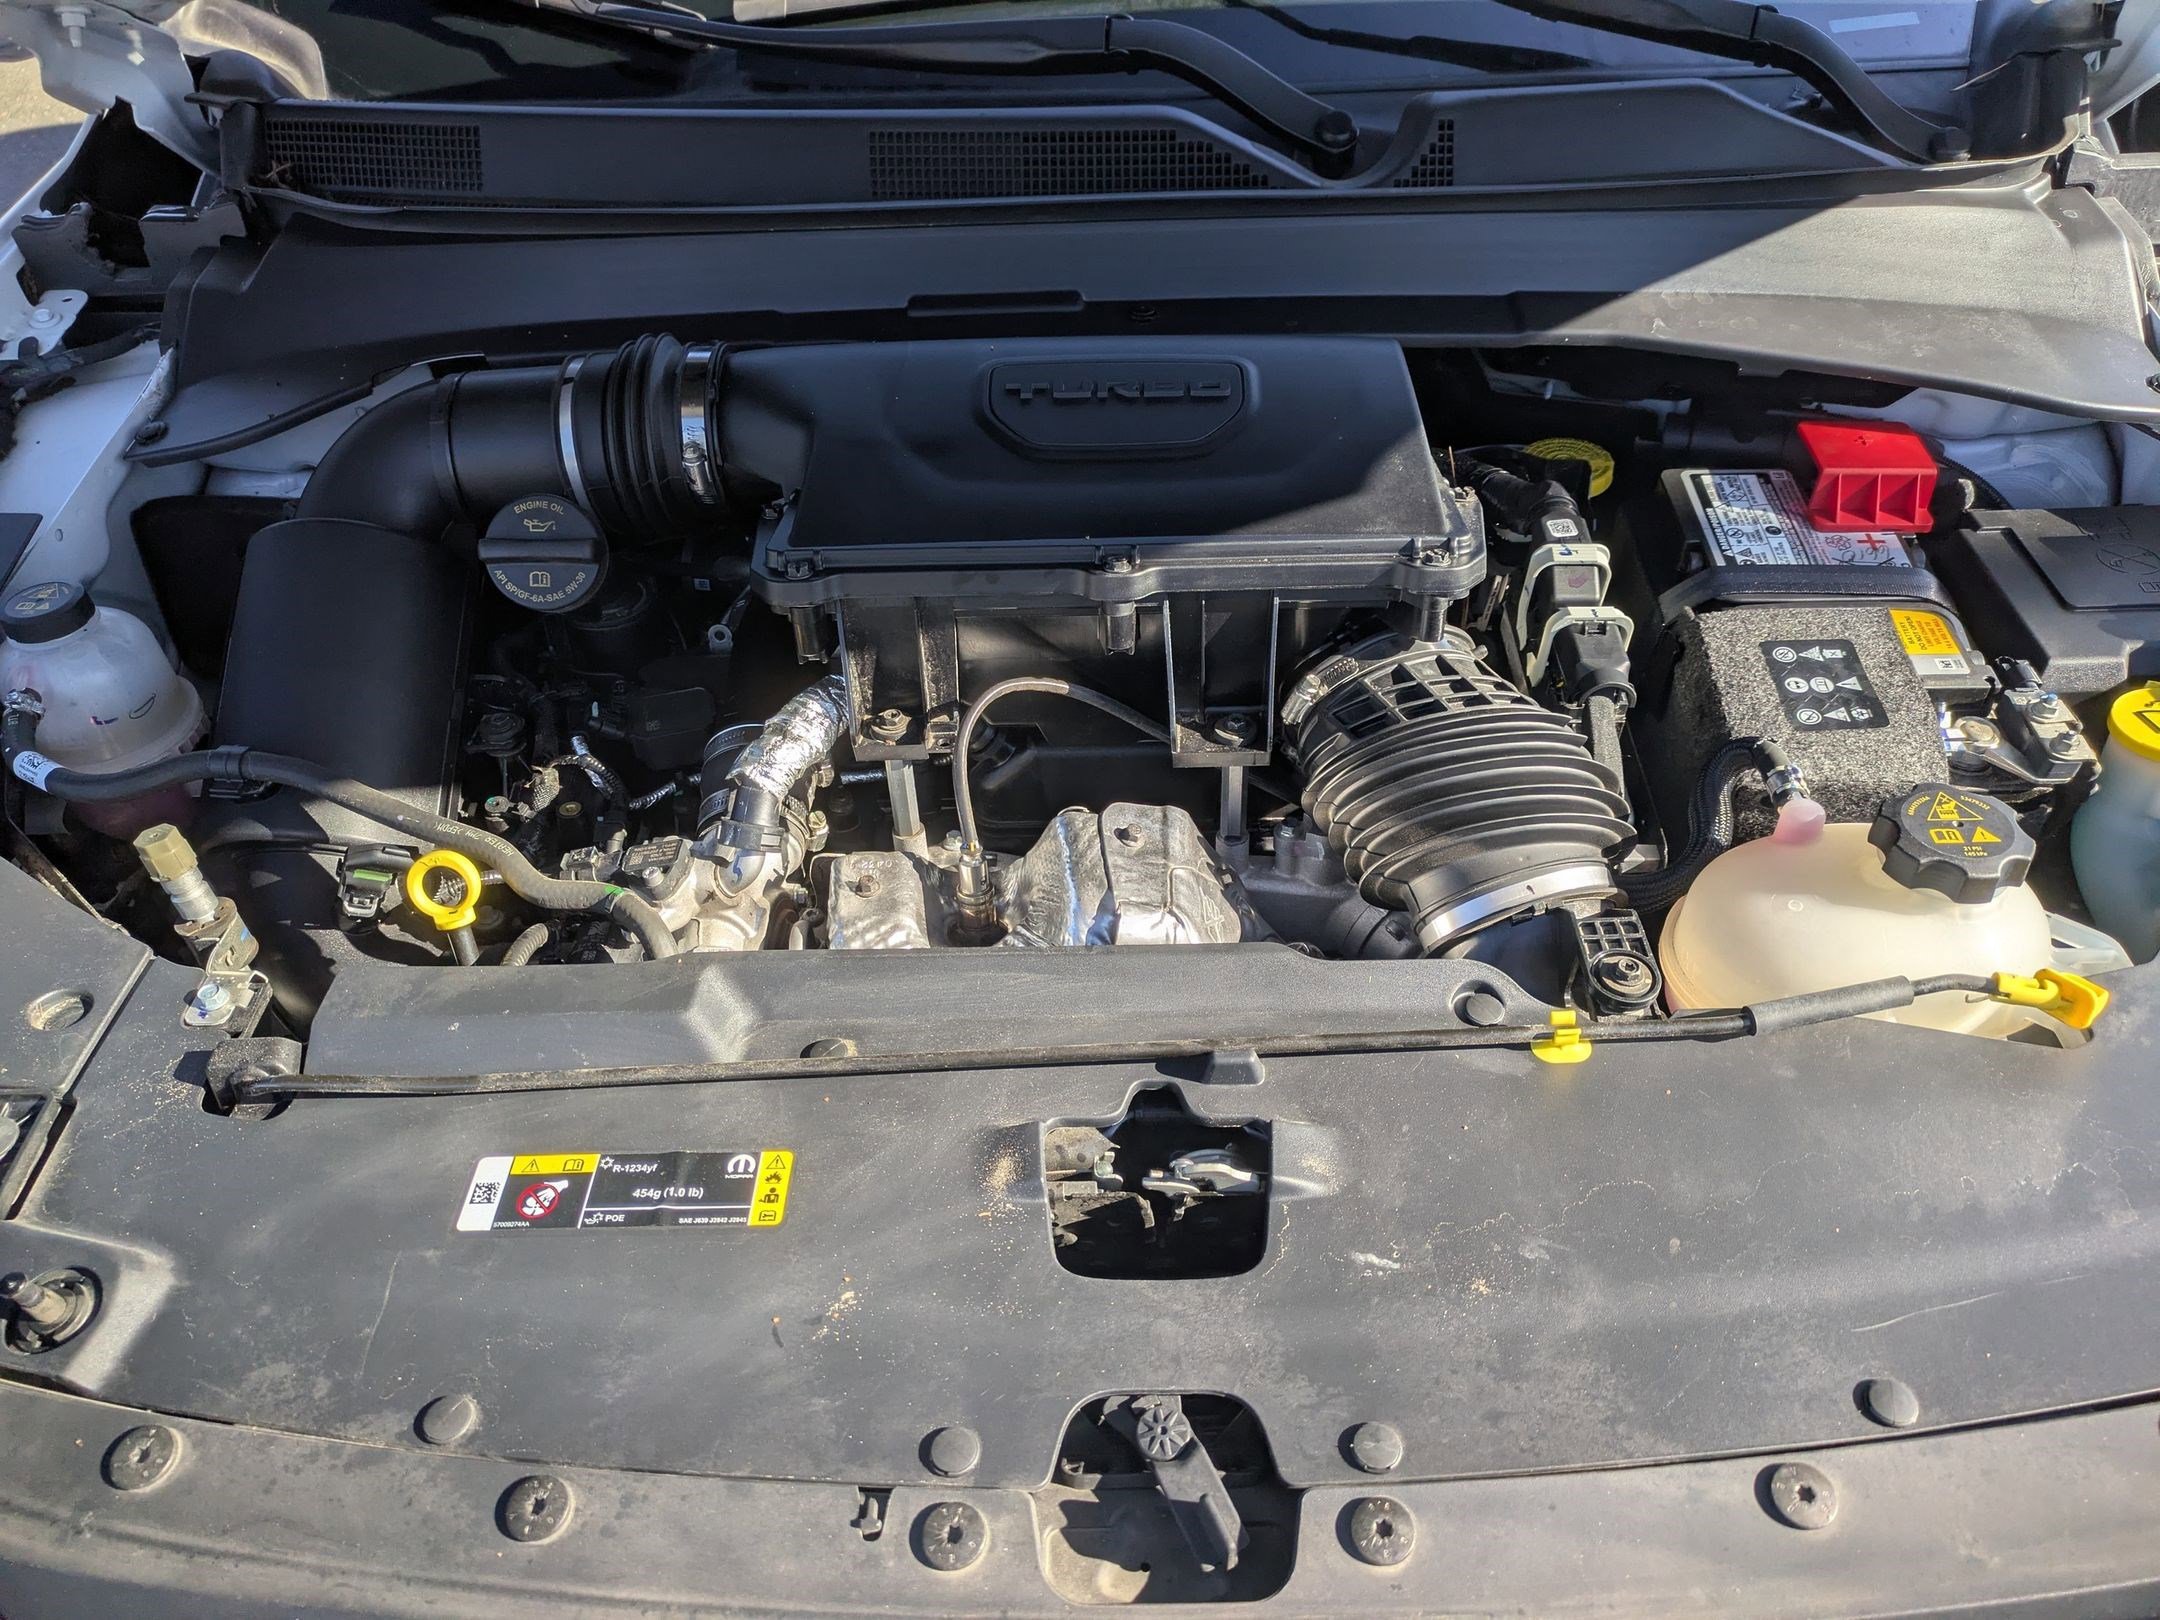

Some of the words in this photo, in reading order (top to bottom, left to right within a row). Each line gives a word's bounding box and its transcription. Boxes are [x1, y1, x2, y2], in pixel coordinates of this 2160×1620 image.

[1005, 380, 1232, 400] TURBO
[514, 500, 549, 514] ENGINE
[550, 502, 565, 515] OIL
[494, 569, 508, 585] API
[565, 571, 586, 594] 5W-30
[484, 836, 516, 857] HEATER
[612, 1163, 659, 1173] R-1234yf
[632, 1188, 661, 1200] 454g
[663, 1187, 686, 1198] (1.0
[687, 1187, 704, 1199] lb)
[605, 1214, 625, 1222] POE
